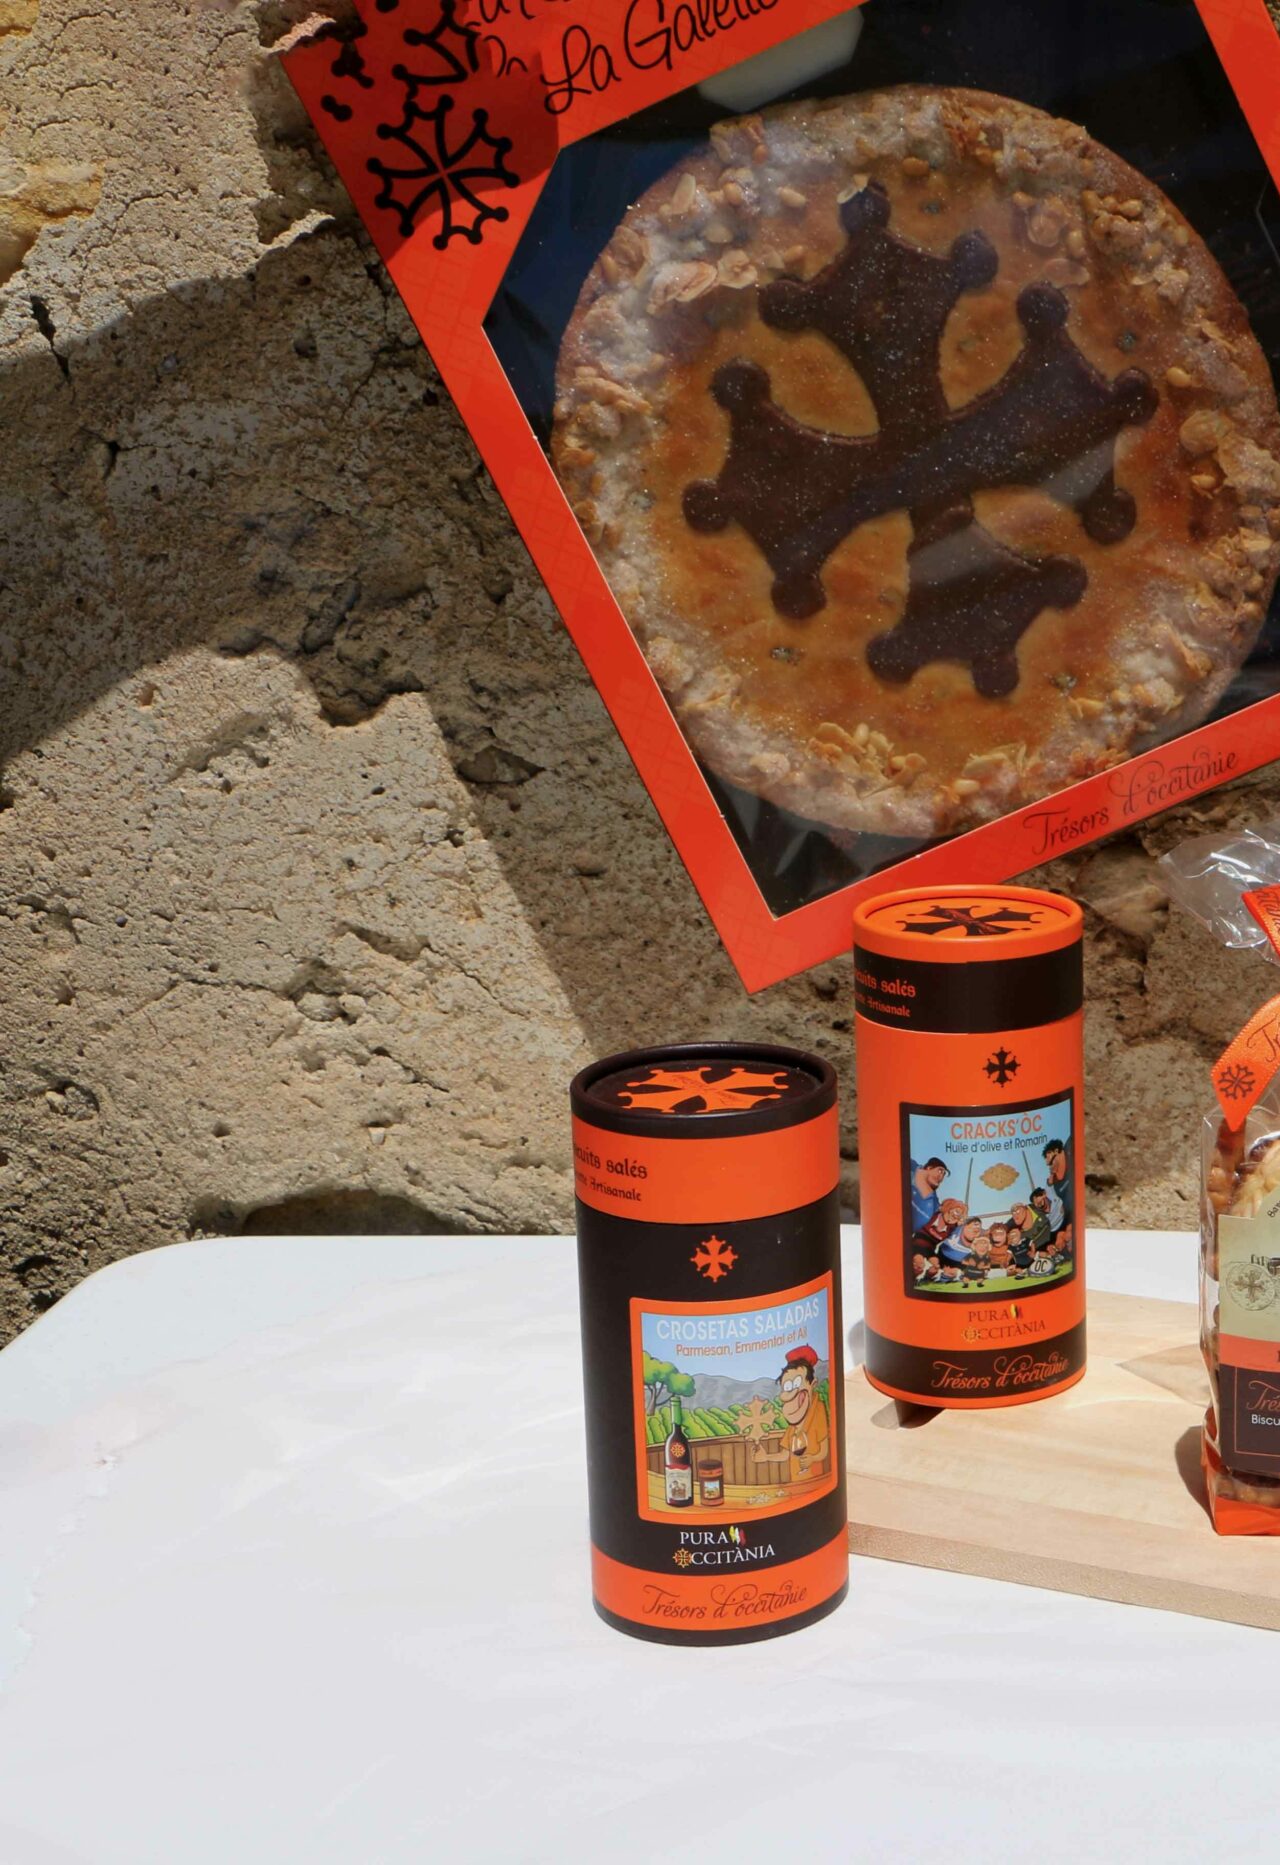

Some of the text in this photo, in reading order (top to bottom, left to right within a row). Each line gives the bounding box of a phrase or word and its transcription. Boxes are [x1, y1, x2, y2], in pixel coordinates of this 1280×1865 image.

[540, 25, 622, 114] La
[624, 0, 779, 71] Gale
[1022, 806, 1110, 855] Trésors
[881, 978, 916, 998] salés
[945, 1133, 1048, 1153] Huile d'olive et Romarin
[606, 1158, 648, 1179] salés
[590, 1176, 642, 1202] Artisanale
[656, 1298, 819, 1341] CROSETAS SALADAS
[968, 1310, 1009, 1323] PURA
[676, 1343, 733, 1357] Parmesan,
[736, 1333, 785, 1354] Emmental
[931, 1360, 991, 1389] Trésors
[680, 1531, 729, 1545] PURA
[642, 1584, 707, 1619] Trésors
